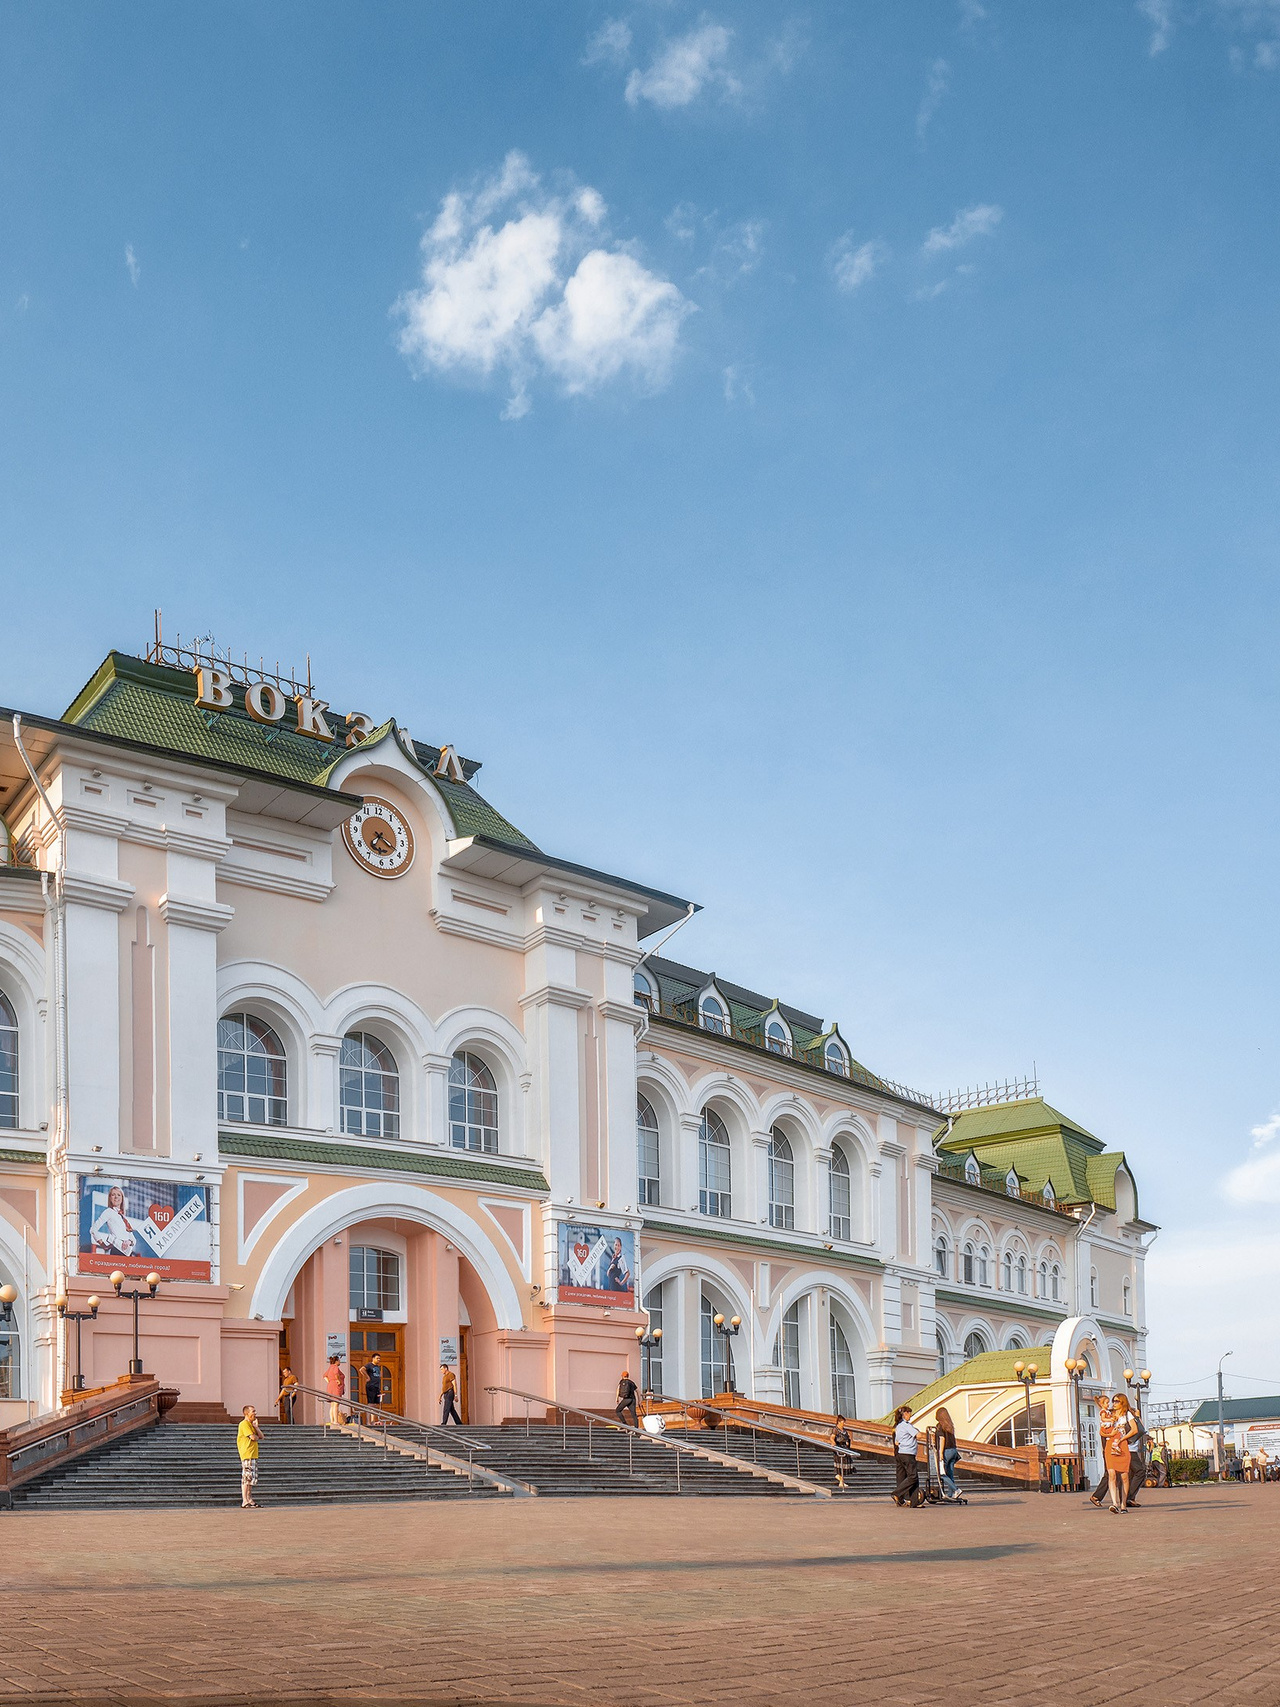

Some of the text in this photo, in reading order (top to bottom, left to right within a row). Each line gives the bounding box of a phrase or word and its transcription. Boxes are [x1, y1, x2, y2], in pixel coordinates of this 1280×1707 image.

[363, 807, 370, 815] 11
[374, 807, 383, 816] 12
[357, 839, 363, 847] 8
[400, 839, 405, 847] 3
[379, 858, 384, 866] 6
[389, 858, 394, 866] 5
[153, 1211, 170, 1222] 160
